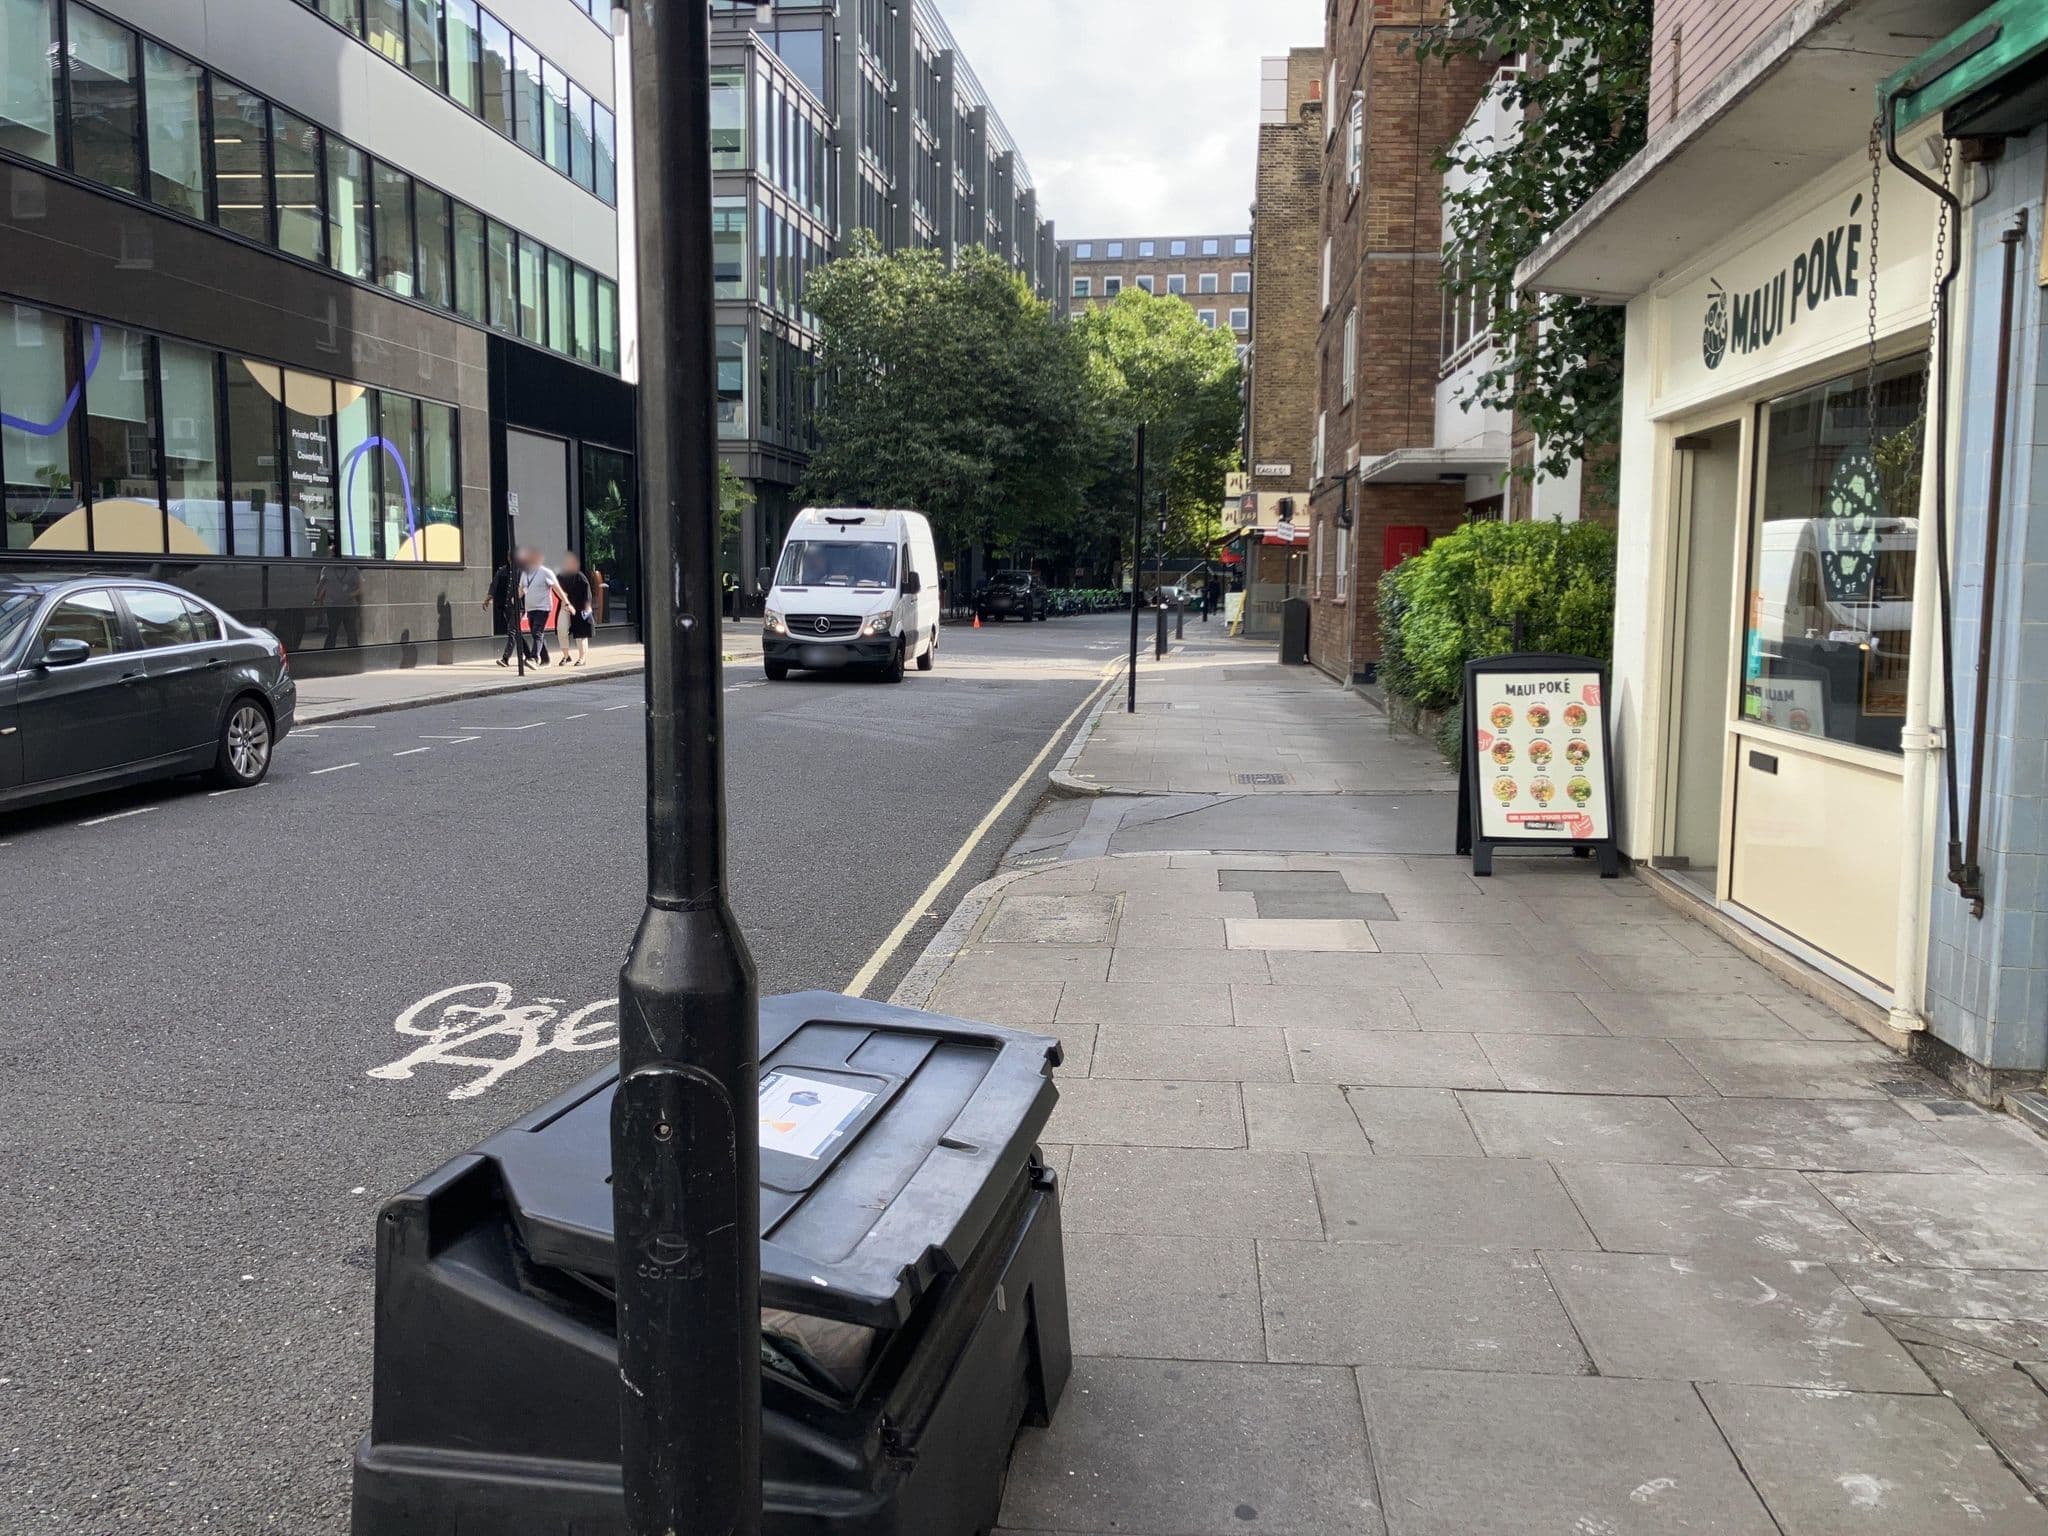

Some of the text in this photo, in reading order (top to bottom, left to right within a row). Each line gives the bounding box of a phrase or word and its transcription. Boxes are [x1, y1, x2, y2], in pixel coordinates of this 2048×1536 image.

[1731, 193, 1863, 354] MAUI POKÉ
[292, 428, 326, 442] Private Offices
[297, 450, 323, 464] Coworking
[292, 471, 329, 483] Meeting Rooms
[299, 492, 324, 503] Happiness
[1845, 582, 1857, 594] OF
[1505, 678, 1571, 697] MAUI POKÉ
